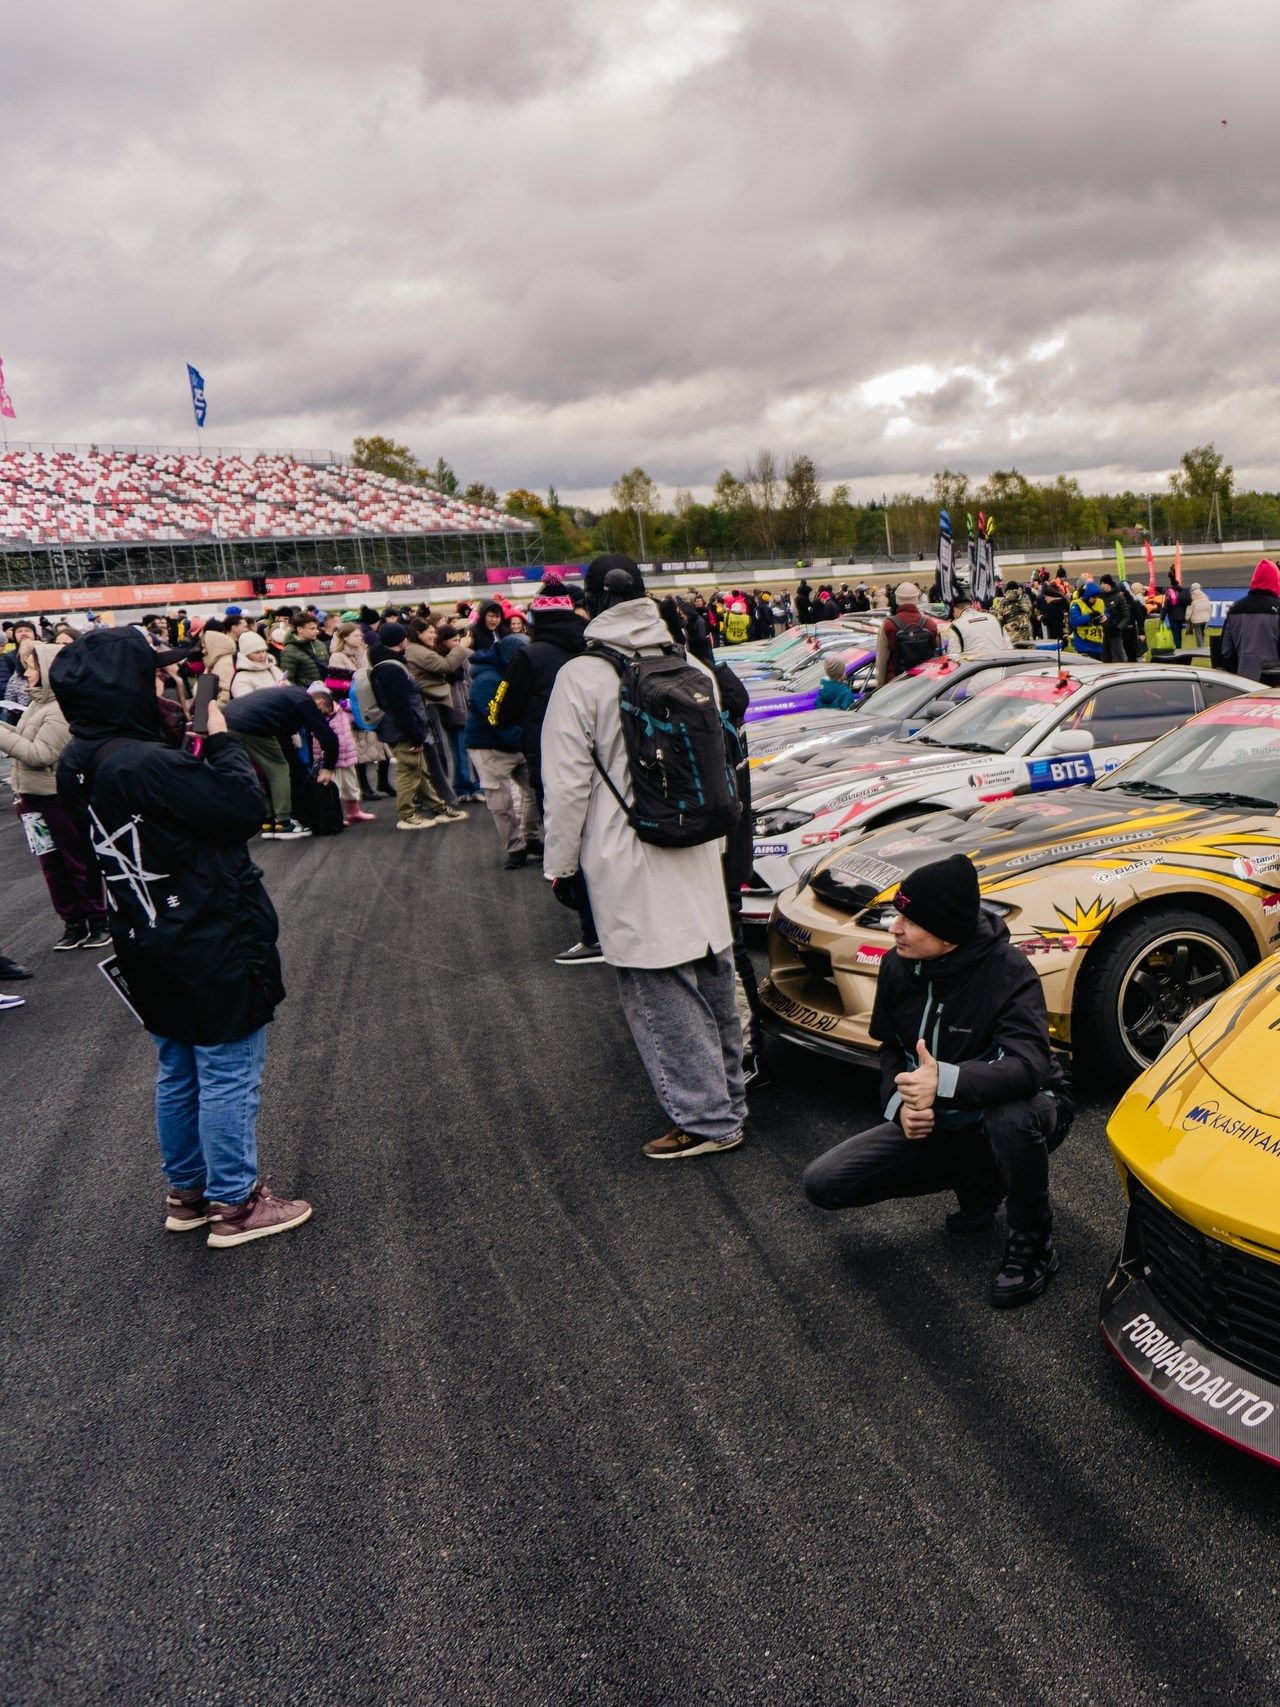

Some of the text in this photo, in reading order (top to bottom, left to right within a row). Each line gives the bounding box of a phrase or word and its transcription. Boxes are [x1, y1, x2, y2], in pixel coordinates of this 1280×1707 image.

[912, 756, 994, 776] DOBROVOLSKIY
[982, 768, 1015, 780] Standard
[1050, 759, 1089, 783] ВТБ
[983, 775, 1011, 786] Springs
[800, 830, 841, 846] CTR
[1052, 831, 1154, 855] LINGLONG
[753, 844, 788, 855] AIMOL
[1114, 856, 1166, 875] ВИРАЖ
[1121, 1312, 1275, 1427] FORWARDAUTO
